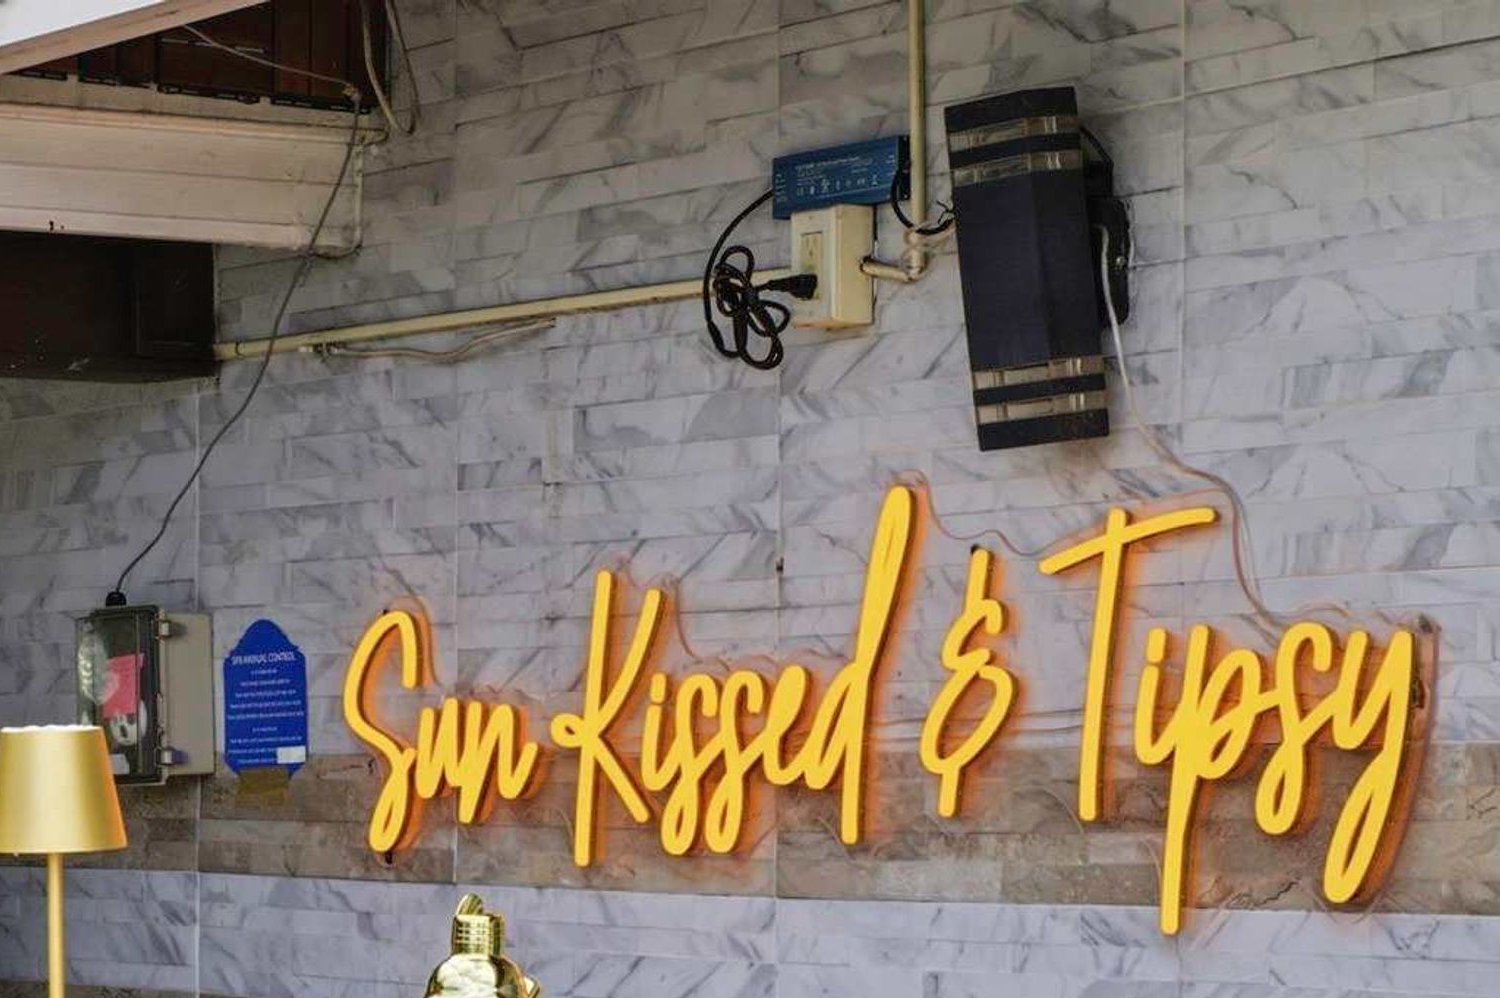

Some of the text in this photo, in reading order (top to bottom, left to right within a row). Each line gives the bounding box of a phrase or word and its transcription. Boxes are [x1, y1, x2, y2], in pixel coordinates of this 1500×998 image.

[344, 486, 1414, 934] Sun Kissed & Tipsy
